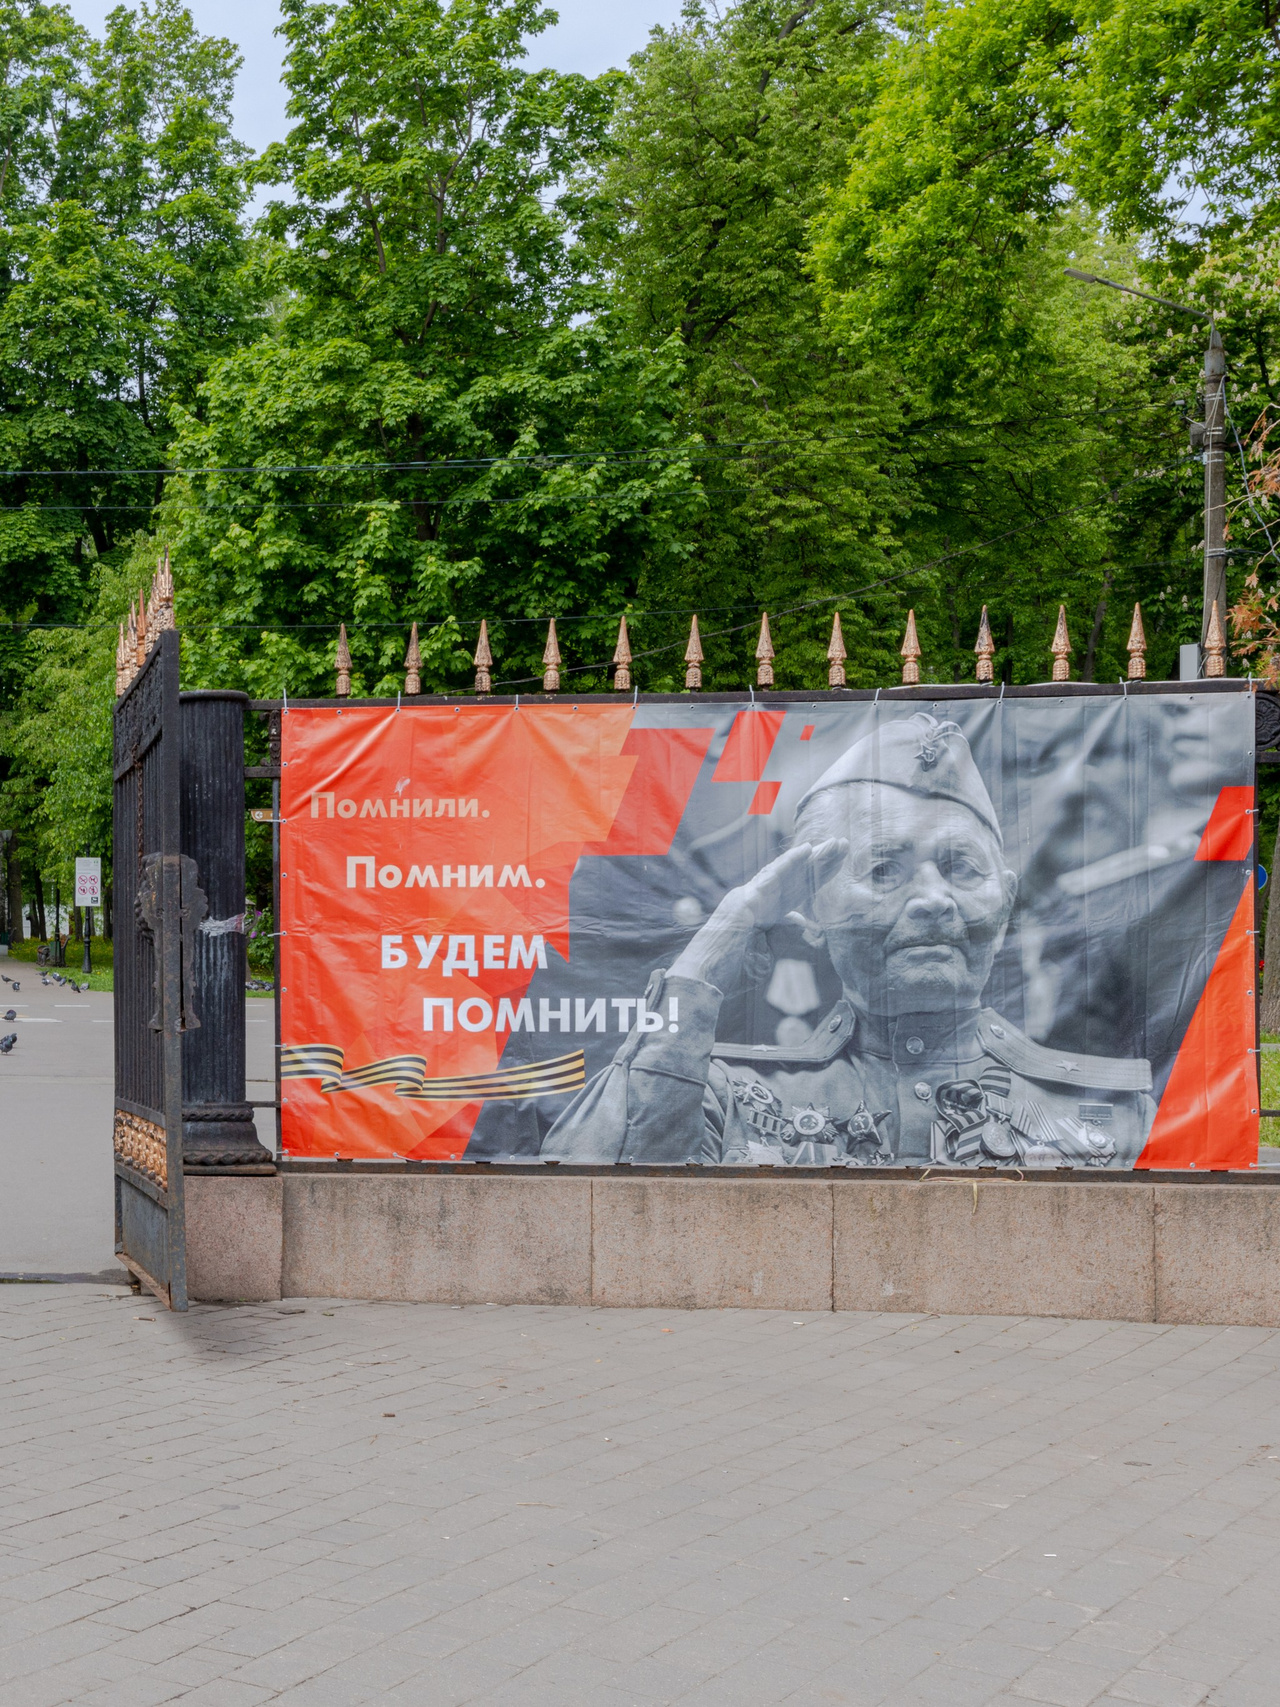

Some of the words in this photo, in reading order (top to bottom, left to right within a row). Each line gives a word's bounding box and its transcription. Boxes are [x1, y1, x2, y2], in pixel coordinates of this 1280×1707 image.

[310, 792, 491, 819] Помнили.
[346, 856, 546, 888] Помним.
[381, 935, 548, 977] БУДЕМ
[423, 997, 680, 1033] ПОМНИТЬ!
